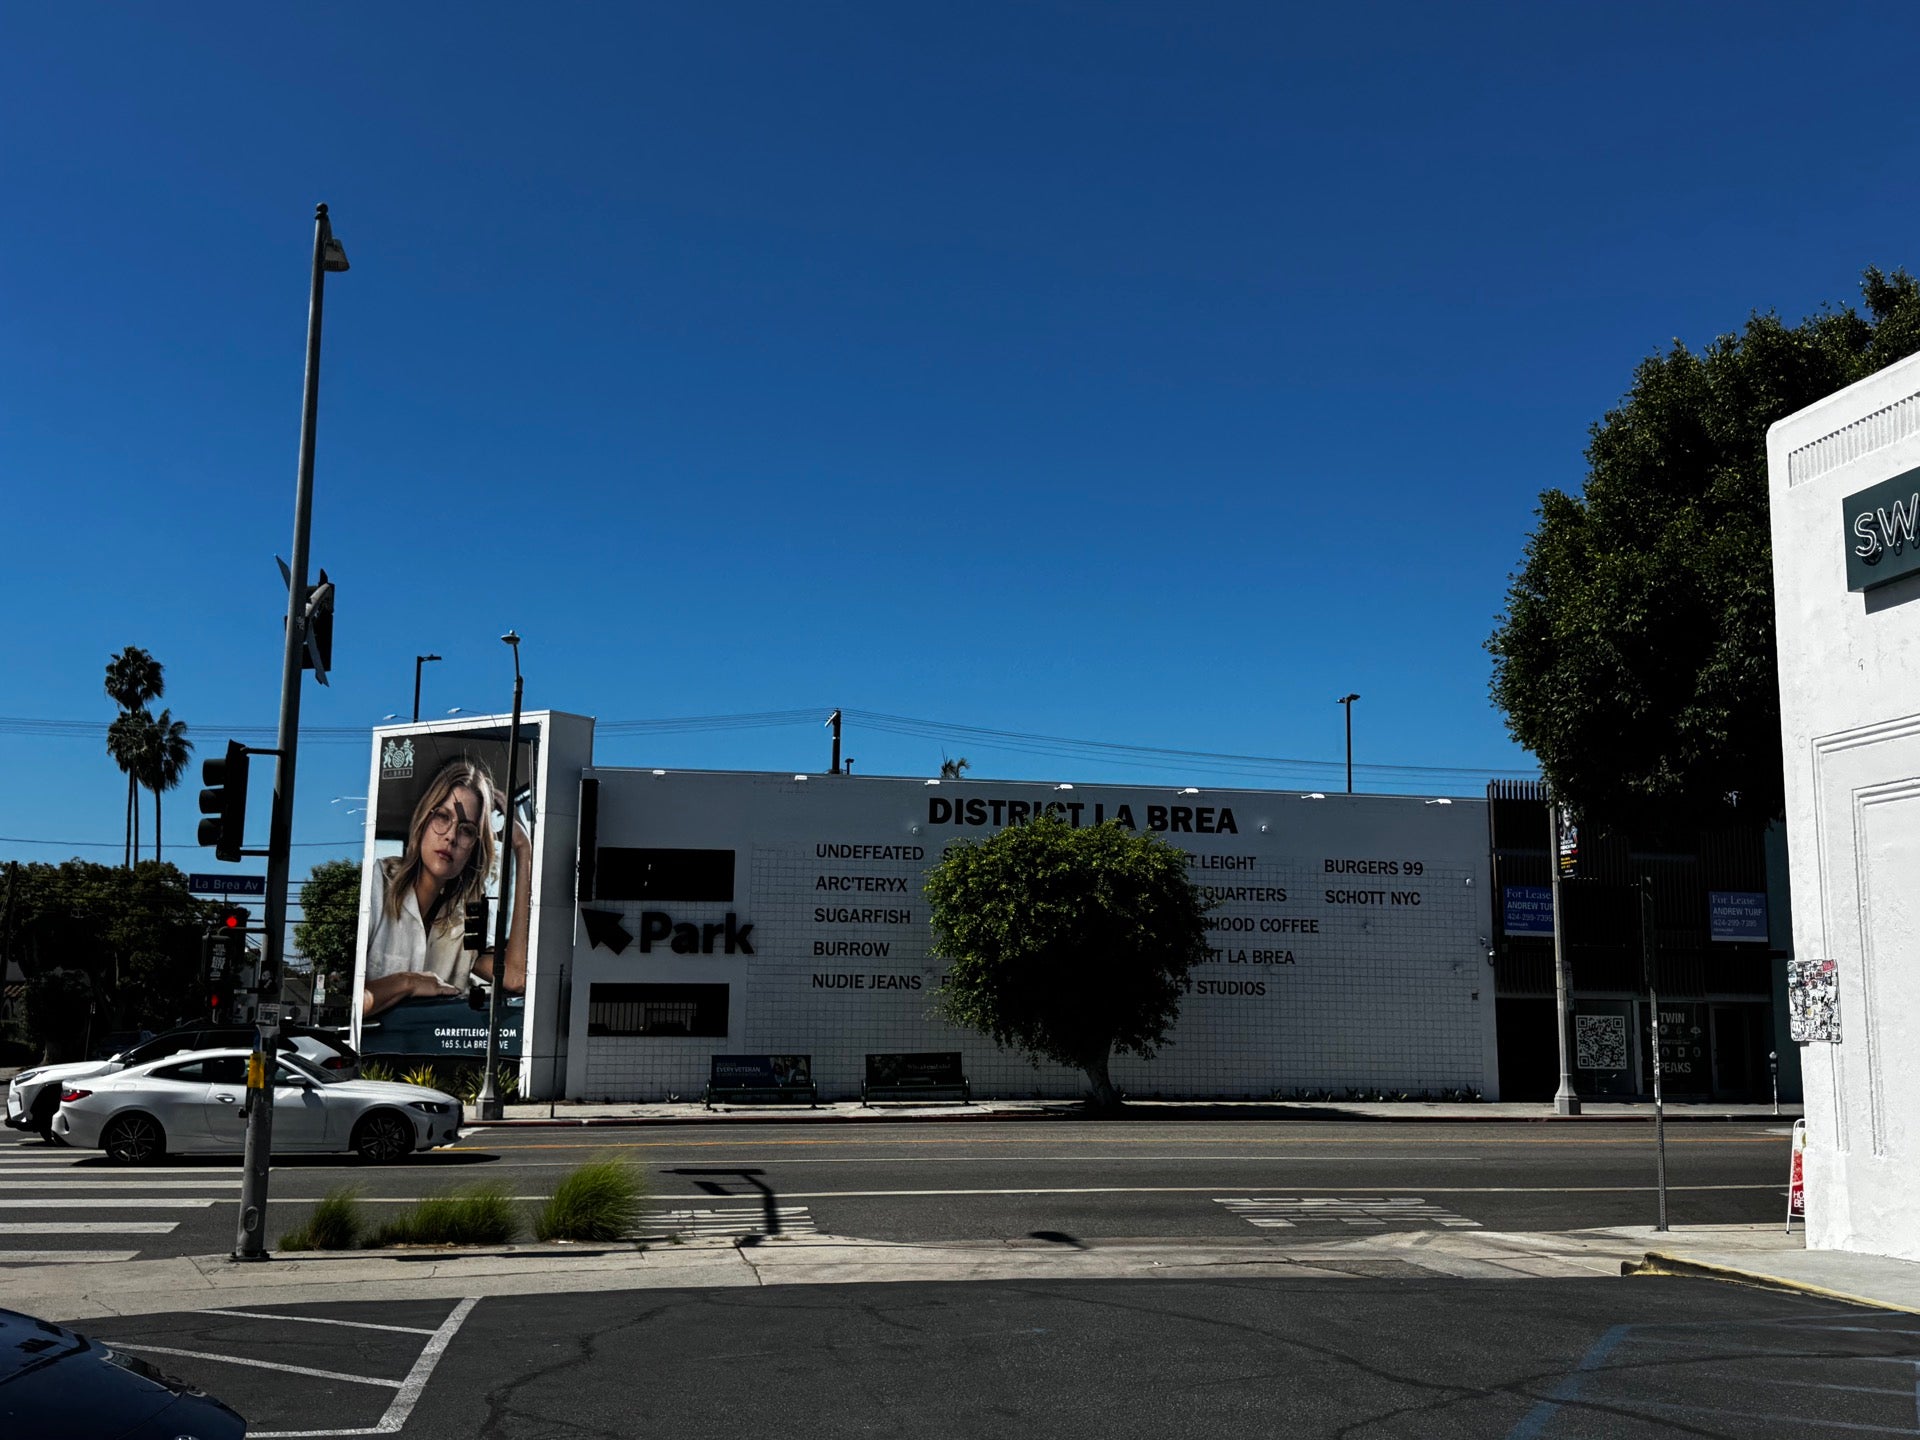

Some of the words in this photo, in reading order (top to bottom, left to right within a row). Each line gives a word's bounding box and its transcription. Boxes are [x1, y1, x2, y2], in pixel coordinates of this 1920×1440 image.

[1147, 805, 1238, 834] BREA
[816, 844, 924, 861] UNDEFEATED
[1201, 856, 1257, 871] LEIGHT
[1324, 859, 1398, 875] BURGERS
[1403, 862, 1424, 876] 99
[195, 878, 209, 889] La
[213, 879, 241, 890] Brea
[244, 880, 259, 891] Av
[816, 876, 907, 893] ARC'TERYX
[1325, 890, 1386, 905] SCHOTT
[1391, 890, 1421, 906] NYC
[1506, 887, 1521, 898] For
[1525, 889, 1552, 900] Lease
[1712, 894, 1726, 905] For
[1507, 901, 1538, 910] ANDREW
[1713, 907, 1743, 916] ANDREW
[814, 908, 911, 924] SUGARFISH
[640, 912, 755, 954] Park
[1260, 918, 1319, 933] COFFEE
[813, 941, 890, 957] BURROW
[1228, 950, 1246, 964] LA
[1252, 950, 1296, 965] BREA
[812, 974, 864, 989] NUDIE
[868, 975, 922, 990] JEANS
[1197, 981, 1266, 996] STUDIOS
[1659, 1012, 1685, 1024] TWIN
[441, 1039, 453, 1048] 165
[455, 1039, 462, 1048] S.
[463, 1039, 472, 1049] LA
[473, 1039, 488, 1049] BRE
[1660, 1061, 1692, 1074] PEAKS
